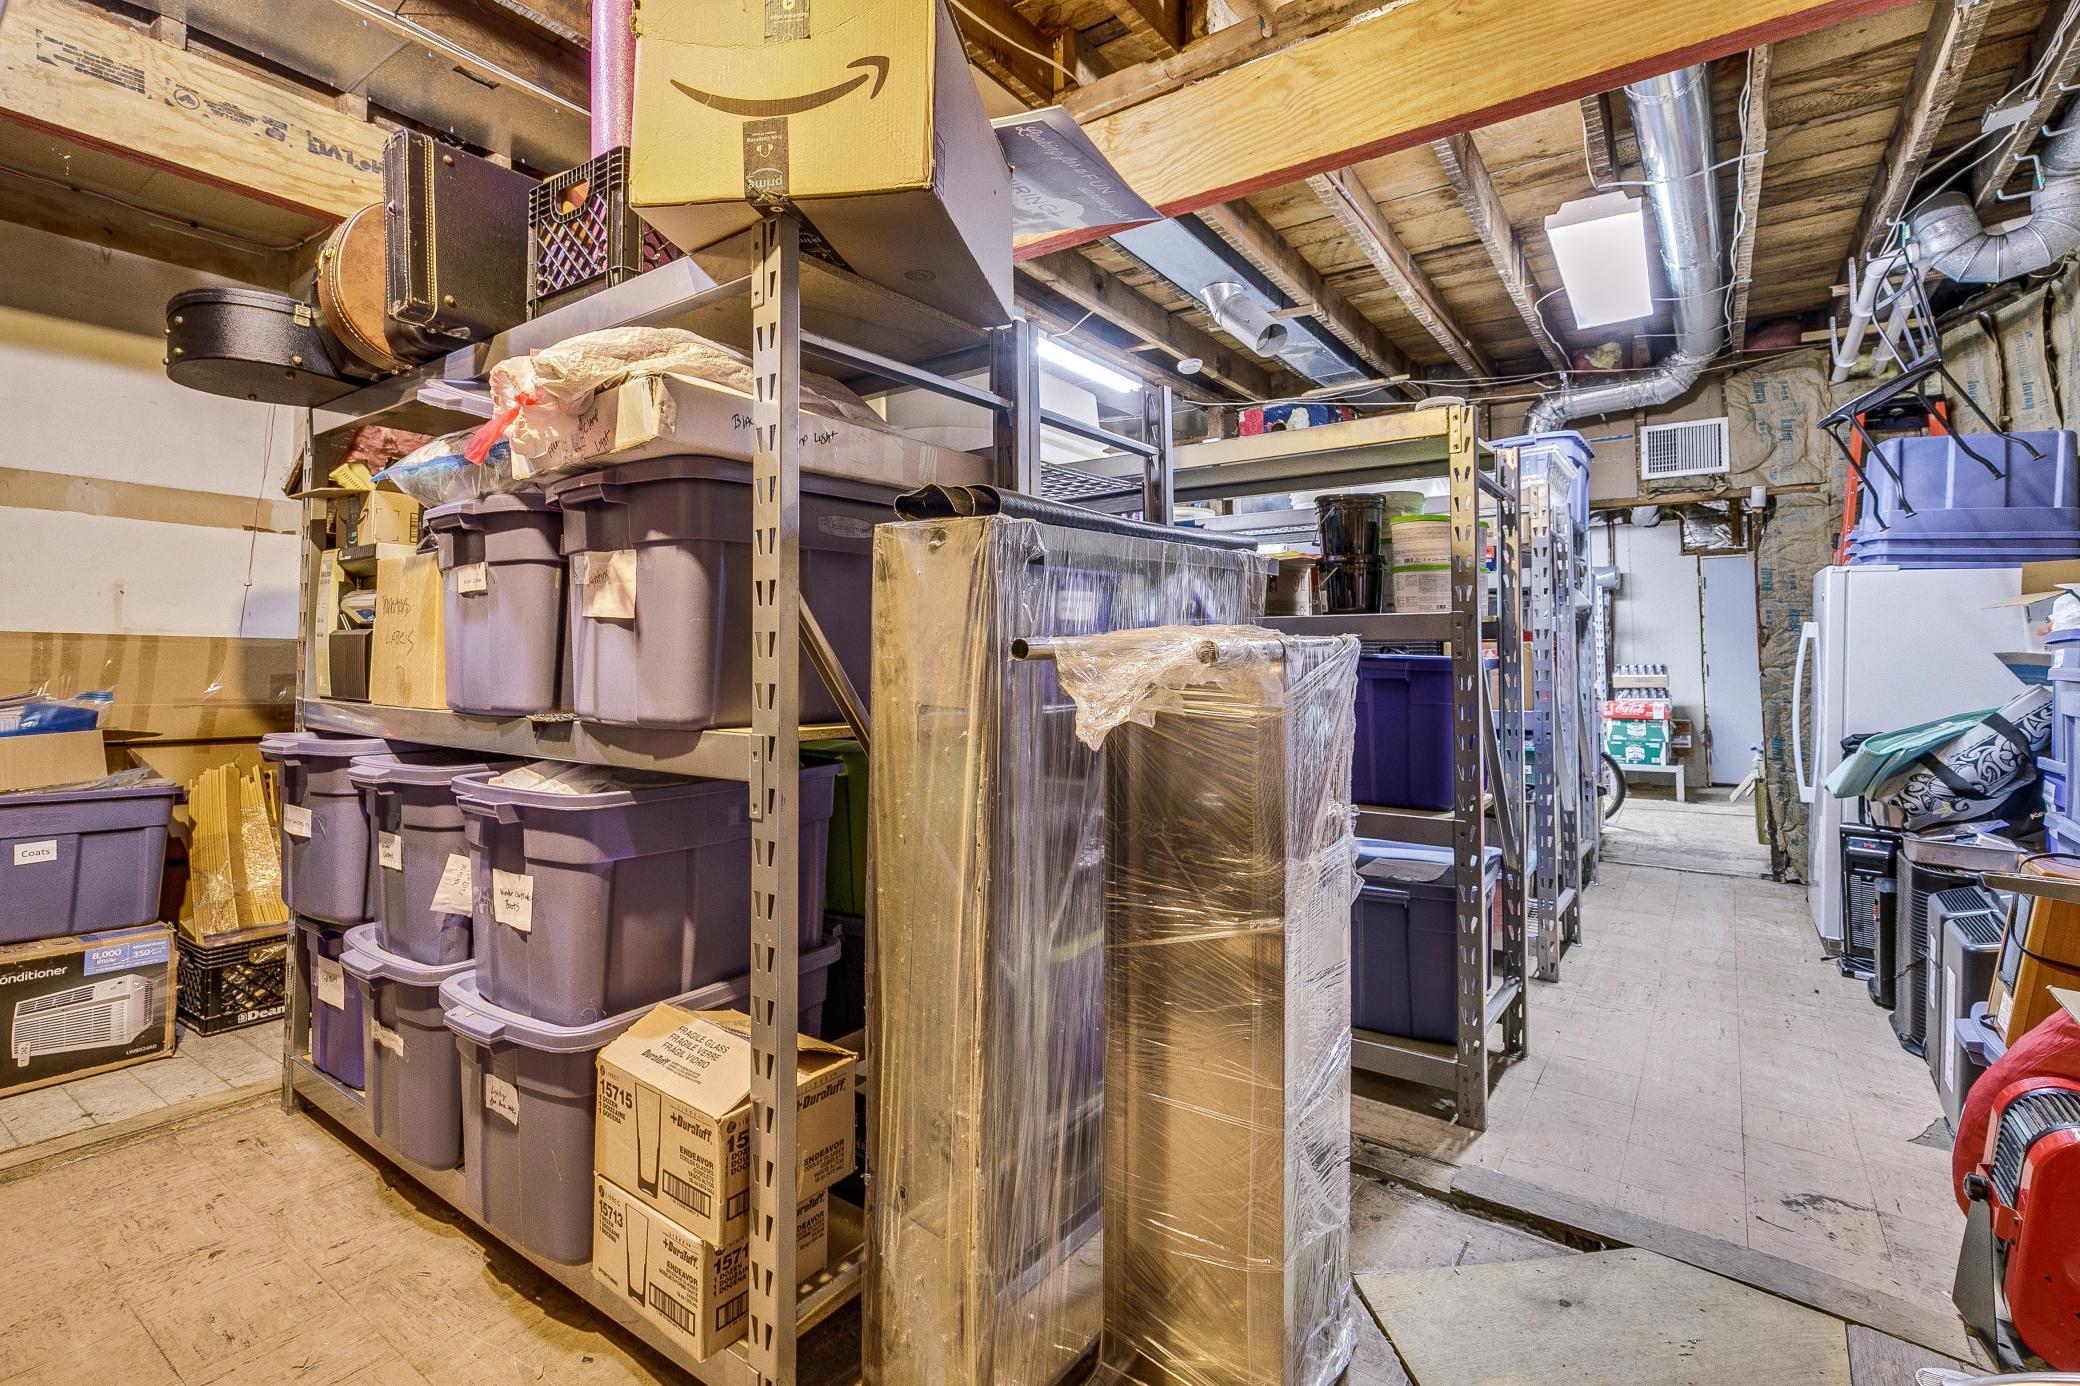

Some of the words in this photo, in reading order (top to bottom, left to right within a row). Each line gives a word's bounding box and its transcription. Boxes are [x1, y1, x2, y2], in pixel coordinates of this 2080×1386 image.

[747, 175, 783, 191] prime
[1081, 173, 1115, 194] FUN
[21, 849, 50, 858] Coats
[91, 949, 121, 961] 8,000
[668, 1033, 698, 1051] FRAGILE
[697, 1046, 721, 1061] VERRE
[676, 1025, 707, 1043] FRAGILE
[704, 1039, 730, 1054] GLASS
[661, 1042, 687, 1058] FRAGIL
[685, 1053, 710, 1068] VIDRIO
[600, 1078, 632, 1109] 15715
[680, 1145, 714, 1170] ENDEAVOR
[804, 1138, 845, 1168] ENDEAVOR
[599, 1200, 623, 1228] 15713
[714, 1243, 749, 1274] 1571
[719, 1261, 742, 1278] DOZEN
[667, 1260, 698, 1286] ENDEAVOR
[719, 1266, 749, 1287] DOUZAIN
[719, 1274, 747, 1294] DOCENA
